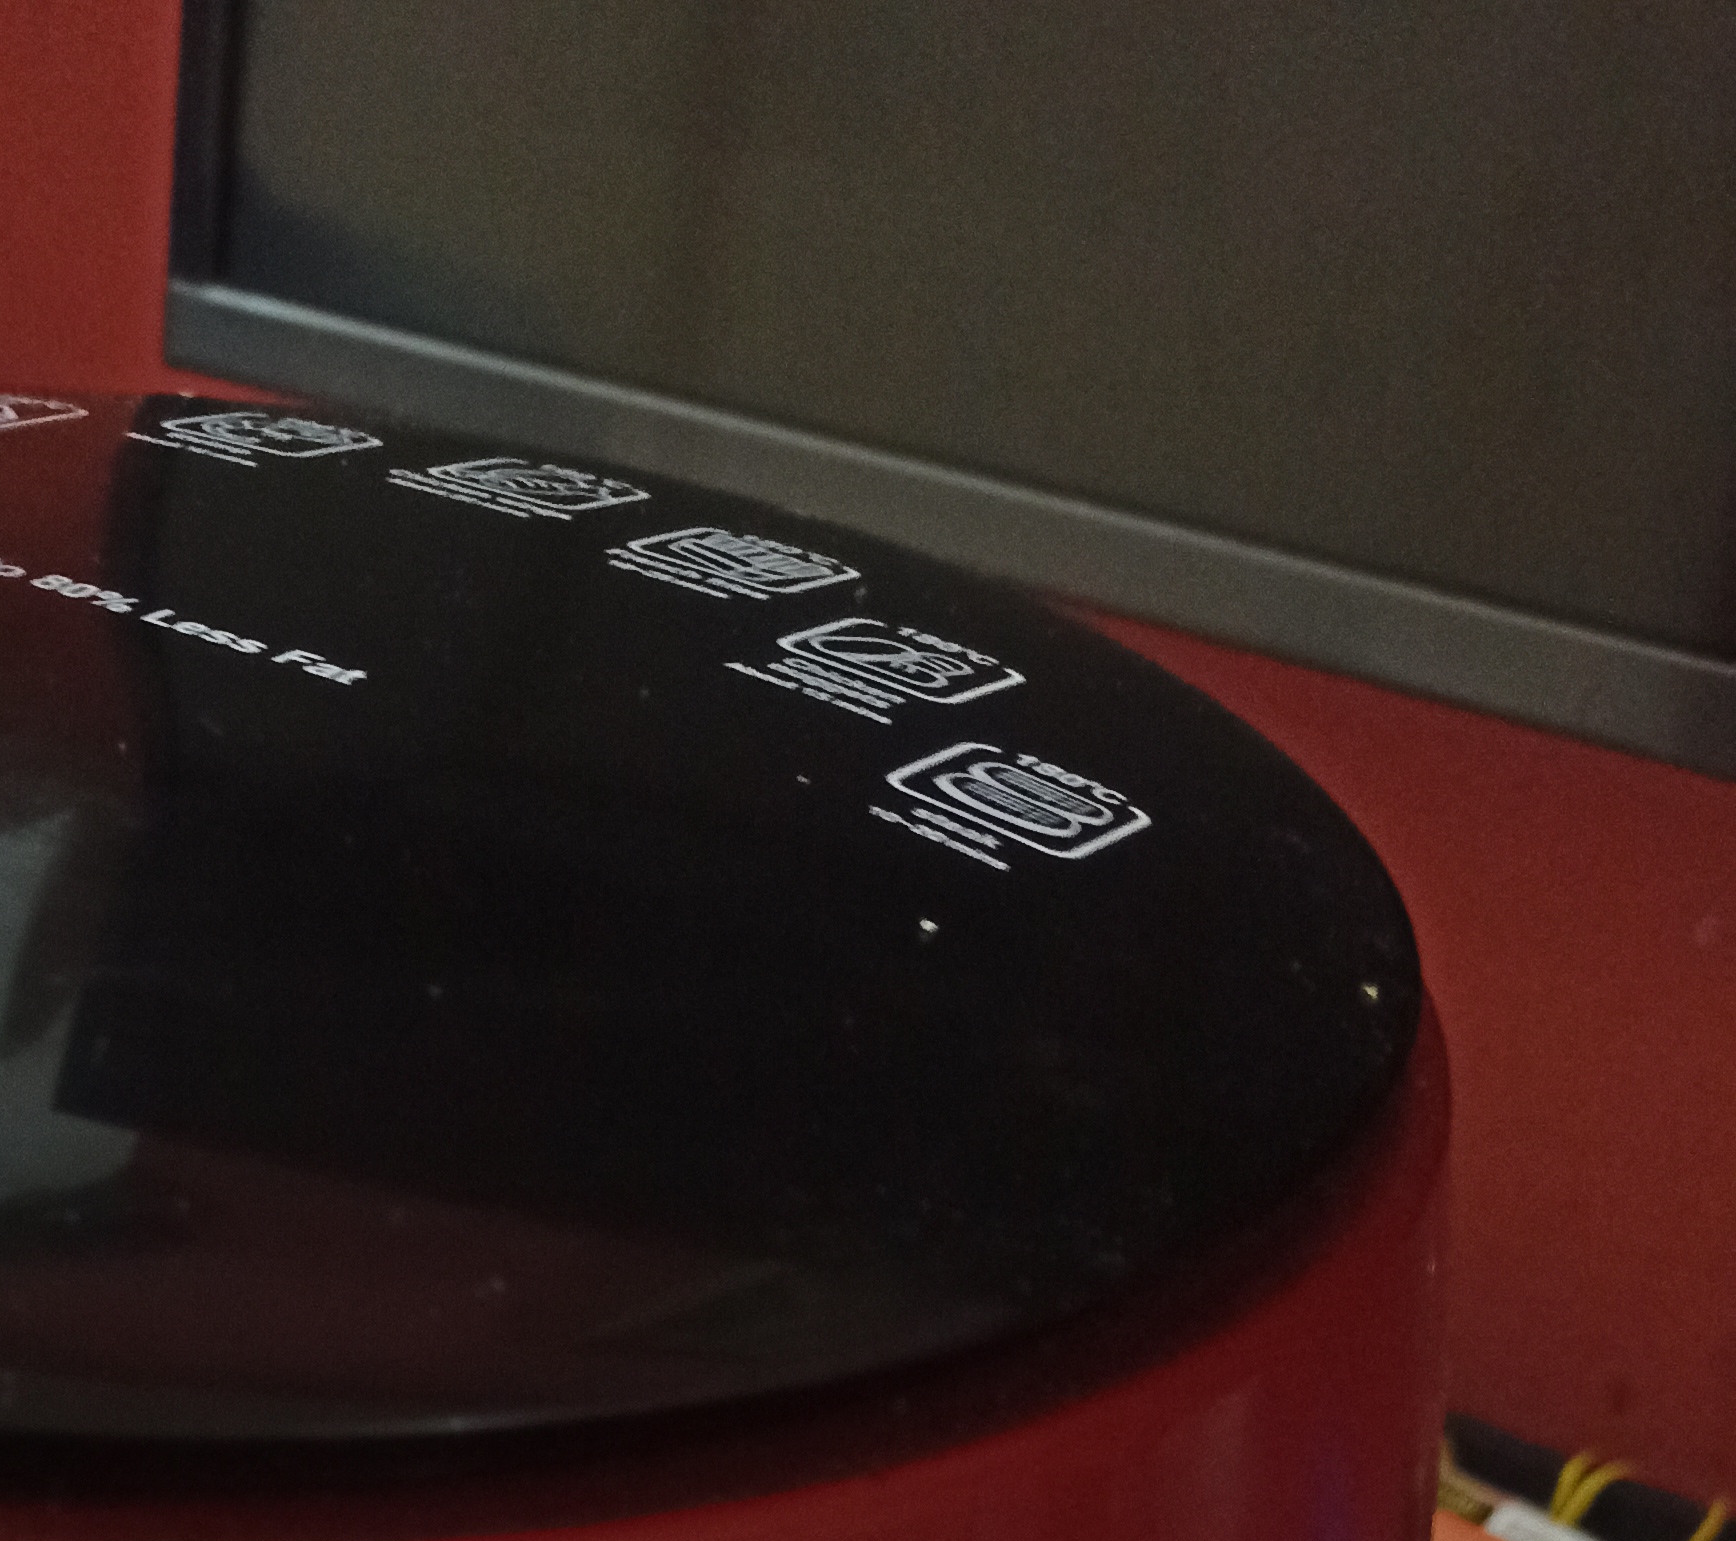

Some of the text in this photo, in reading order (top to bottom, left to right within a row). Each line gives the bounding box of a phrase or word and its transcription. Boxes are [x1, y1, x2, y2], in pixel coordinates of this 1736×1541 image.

[29, 573, 140, 614] 80%
[139, 608, 269, 655] Less
[270, 649, 368, 686] Fat
